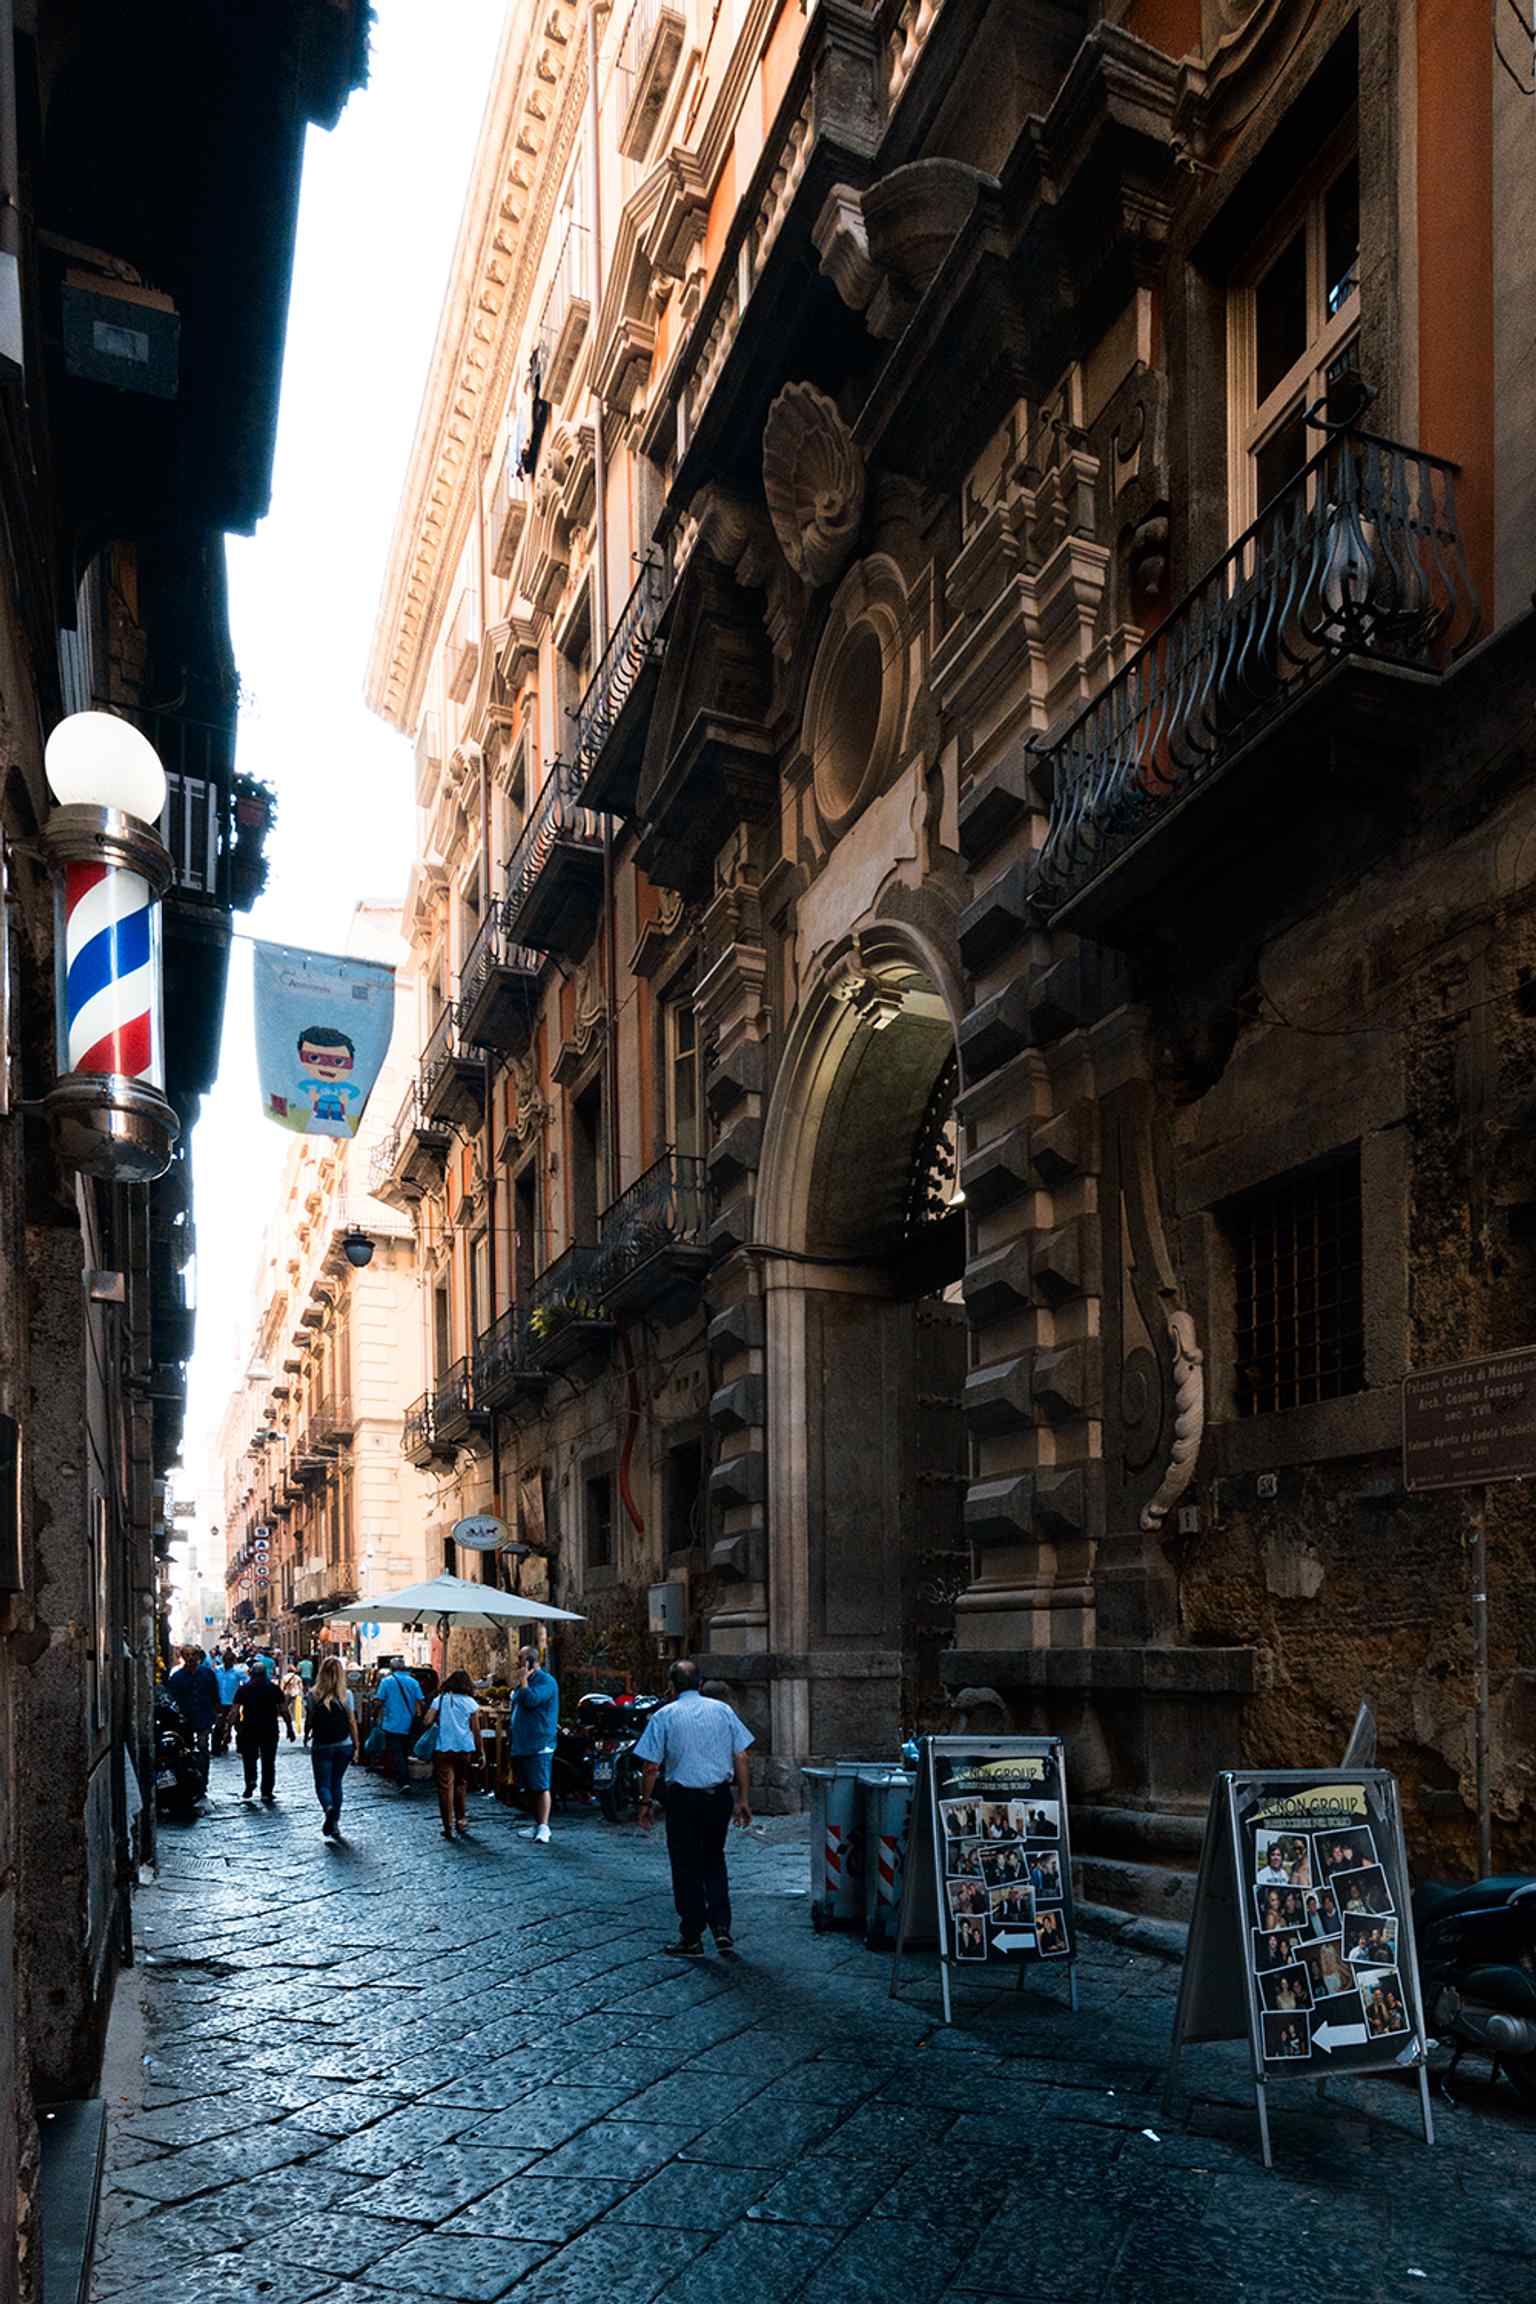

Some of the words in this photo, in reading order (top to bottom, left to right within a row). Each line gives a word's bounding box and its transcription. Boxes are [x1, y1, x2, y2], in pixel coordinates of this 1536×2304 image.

[1442, 1370, 1473, 1387] Carafa
[1476, 1368, 1486, 1382] di
[994, 1767, 1037, 1781] GROUP
[1310, 1797, 1358, 1816] GROUP
